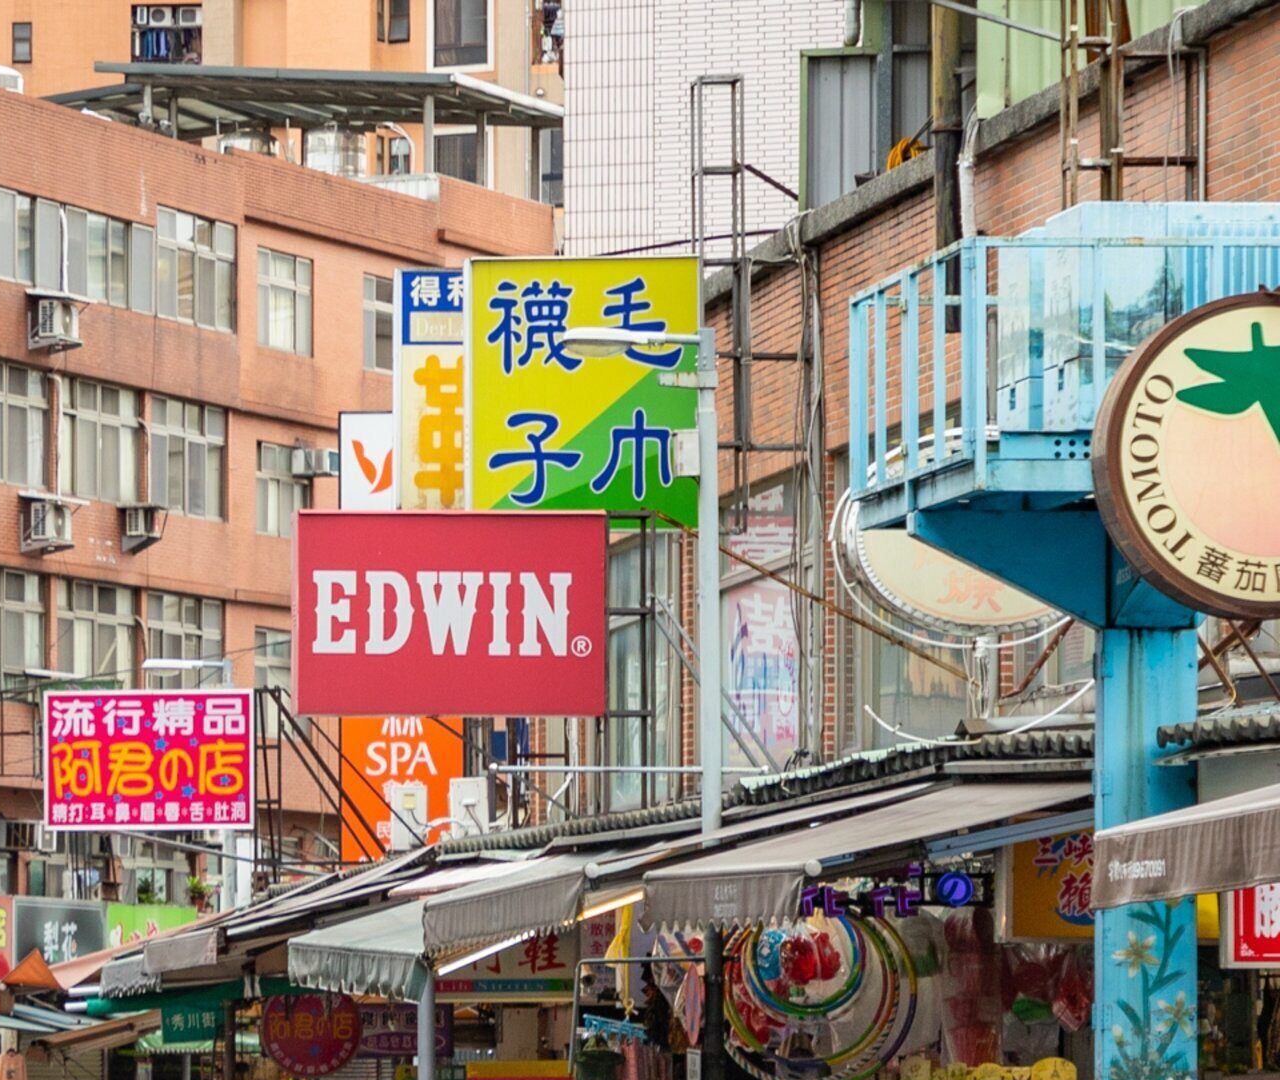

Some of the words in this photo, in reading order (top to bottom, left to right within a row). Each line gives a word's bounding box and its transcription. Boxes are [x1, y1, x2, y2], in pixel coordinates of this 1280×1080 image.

[1129, 373, 1194, 562] TOMOTO
[1195, 546, 1280, 595] 蕃茄
[311, 569, 573, 657] EDWIN
[51, 697, 246, 738] 流行精品
[51, 738, 246, 800] 阿君の店
[364, 741, 438, 777] SPA
[171, 1012, 216, 1032] 秀川街
